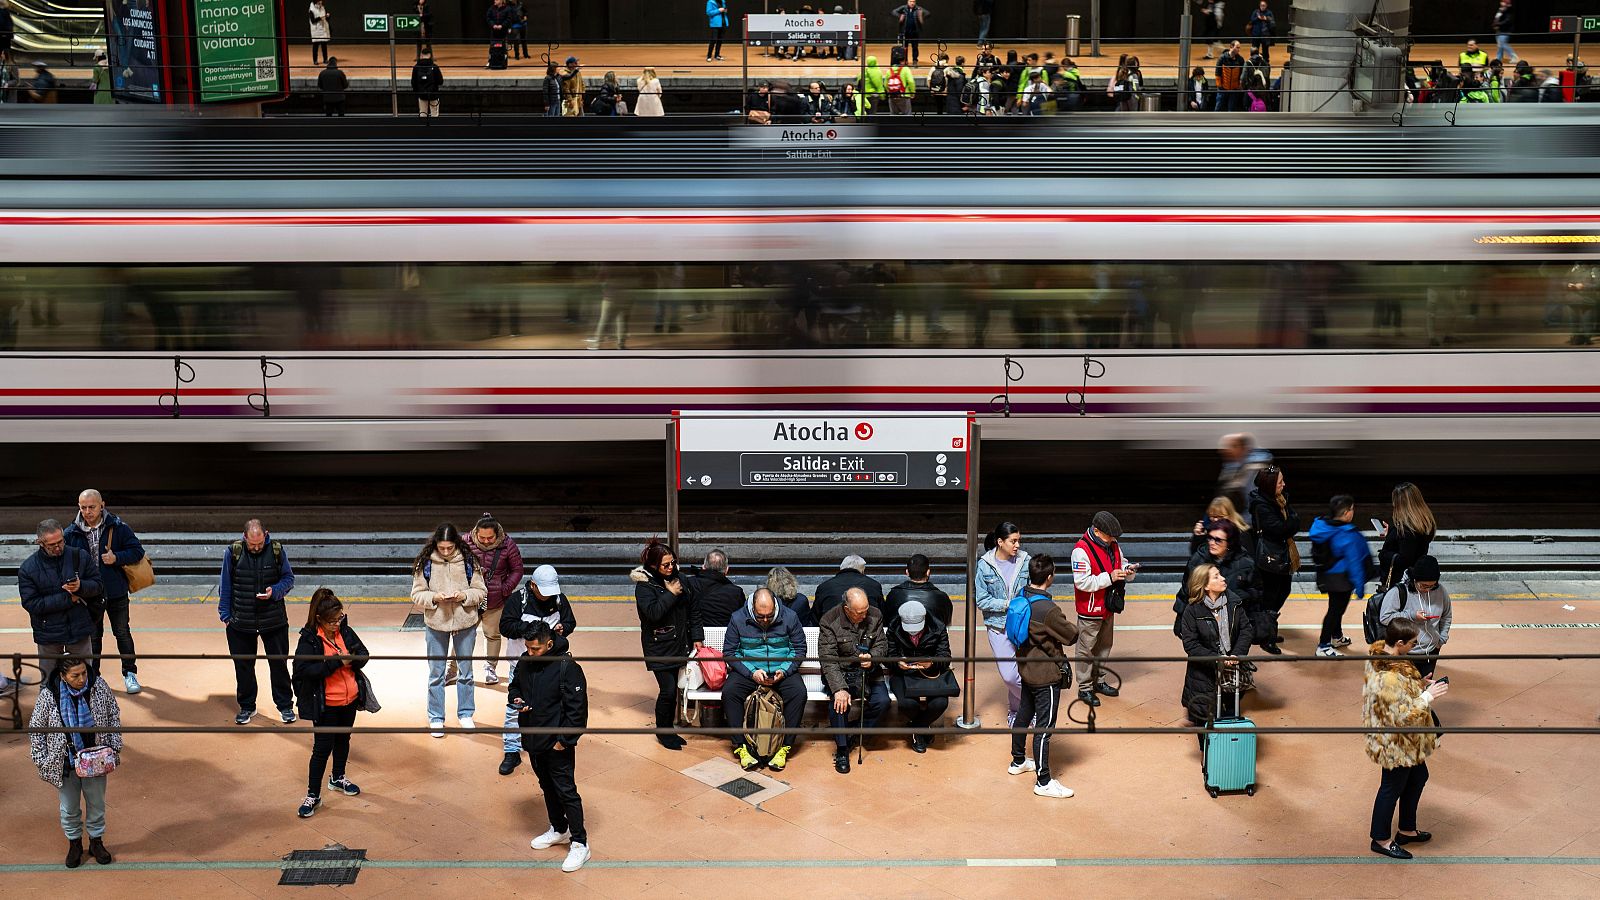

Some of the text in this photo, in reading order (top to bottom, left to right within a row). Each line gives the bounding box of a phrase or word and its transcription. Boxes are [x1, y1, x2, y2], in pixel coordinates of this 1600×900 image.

[130, 8, 152, 20] CUIDAMOS
[201, 4, 265, 18] mano que
[122, 17, 153, 30] LOS ANUNCIOS
[201, 20, 239, 35] cripto
[784, 18, 815, 27] Atocha
[133, 38, 155, 50] CUIDARTE
[203, 33, 255, 50] volando
[147, 51, 156, 60] A TI
[205, 71, 253, 83] que construyen
[780, 128, 824, 142] Atocha
[786, 149, 832, 159] Salida Exit
[773, 421, 849, 441] Atocha
[783, 456, 865, 471] Salida Exit
[842, 473, 853, 482] T4
